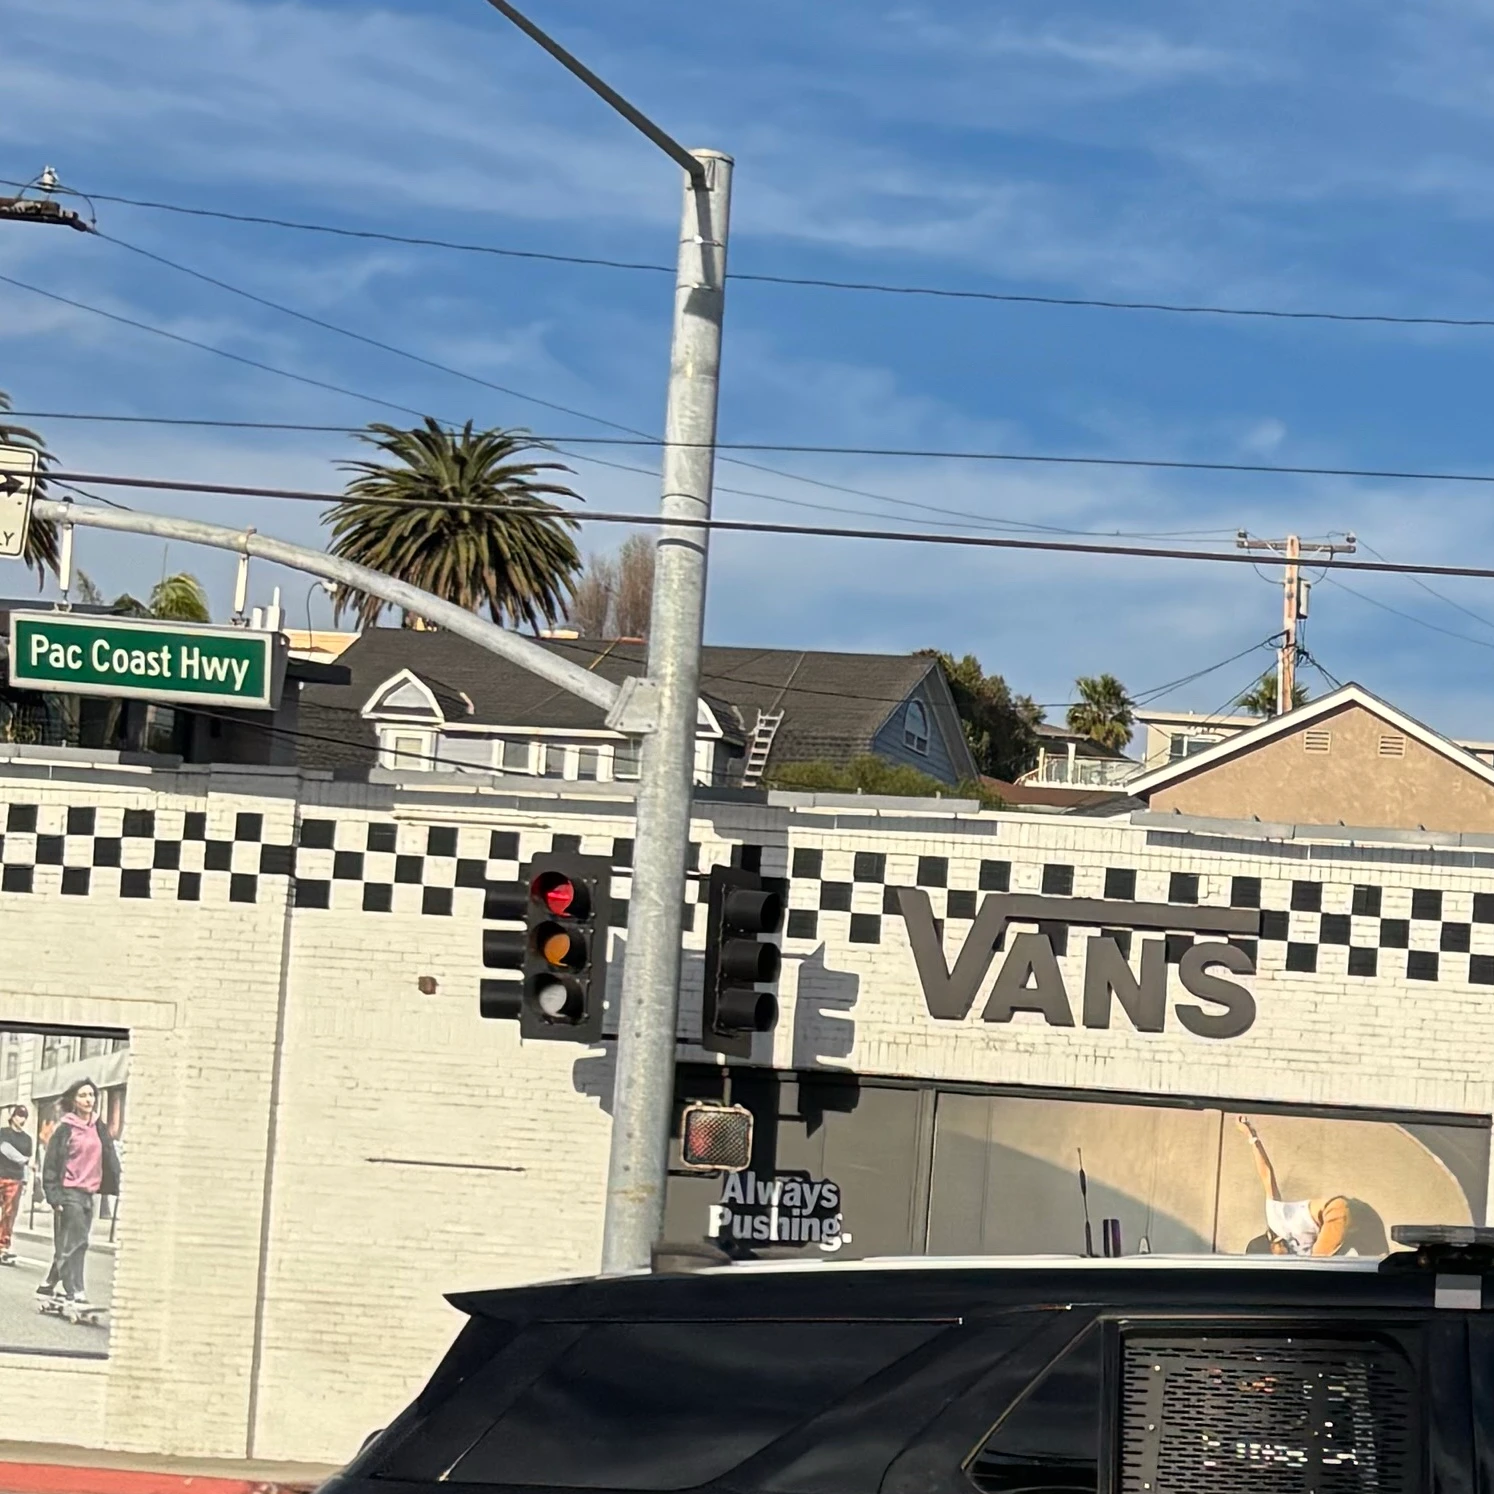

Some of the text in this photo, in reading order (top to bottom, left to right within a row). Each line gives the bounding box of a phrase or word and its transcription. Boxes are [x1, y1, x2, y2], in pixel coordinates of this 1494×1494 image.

[31, 633, 249, 691] Pac Coast Hwy
[897, 885, 1259, 1039] VANS
[721, 1171, 838, 1216] Always
